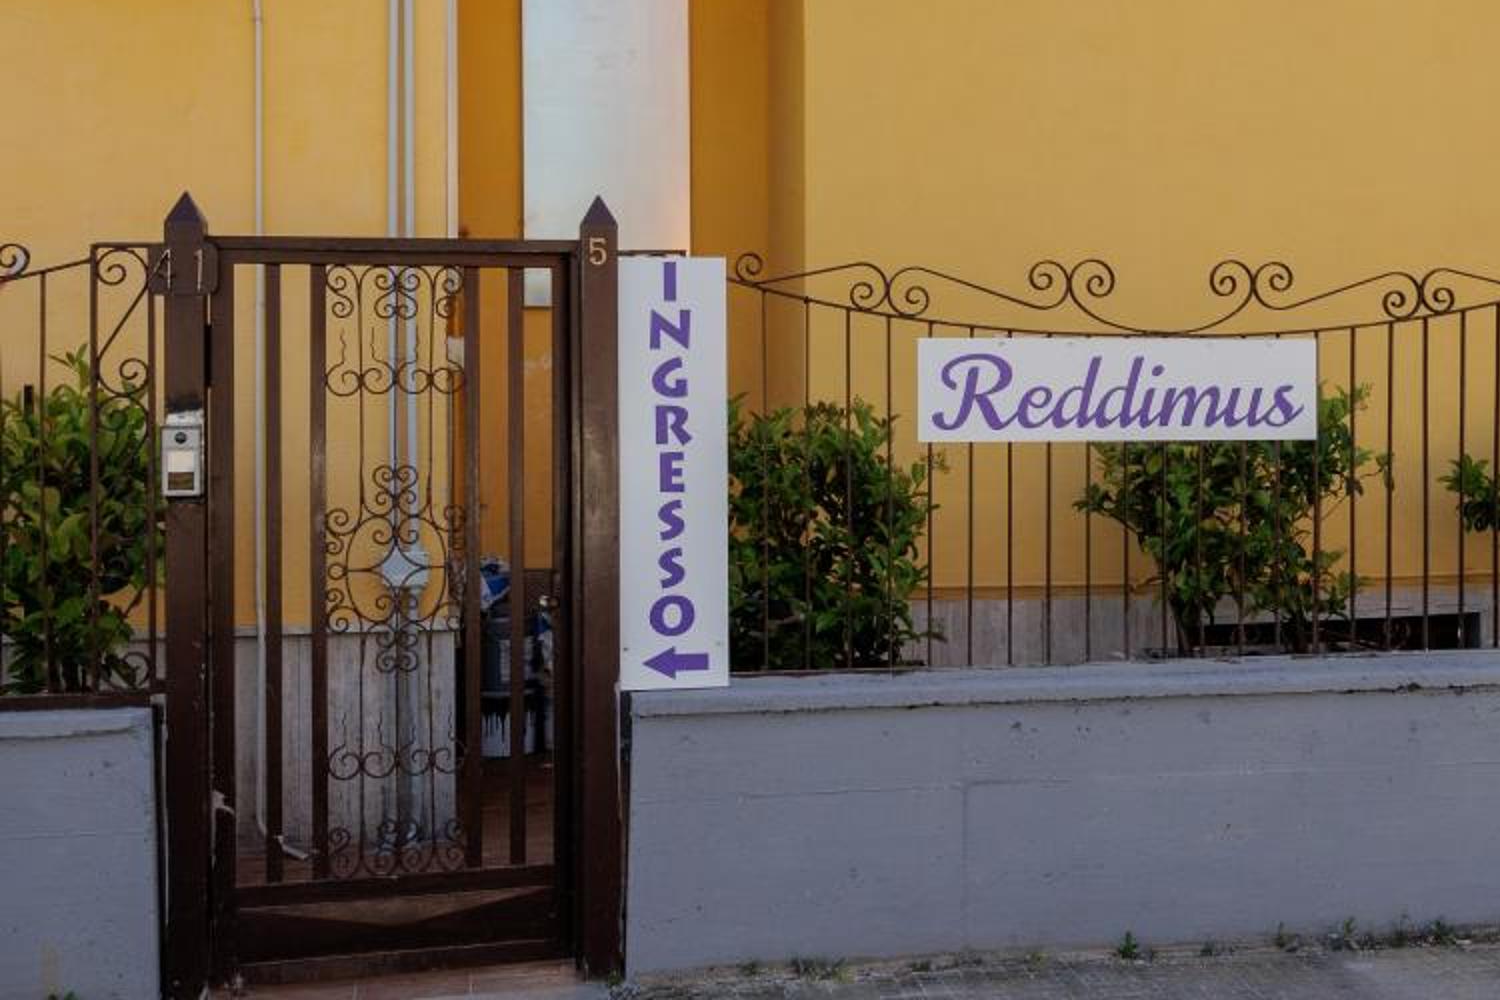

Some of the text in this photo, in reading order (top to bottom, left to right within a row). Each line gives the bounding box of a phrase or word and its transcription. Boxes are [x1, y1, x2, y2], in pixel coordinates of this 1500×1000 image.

[589, 237, 607, 265] 5
[932, 353, 1304, 431] Reddimus
[649, 261, 696, 638] INGRESSO
